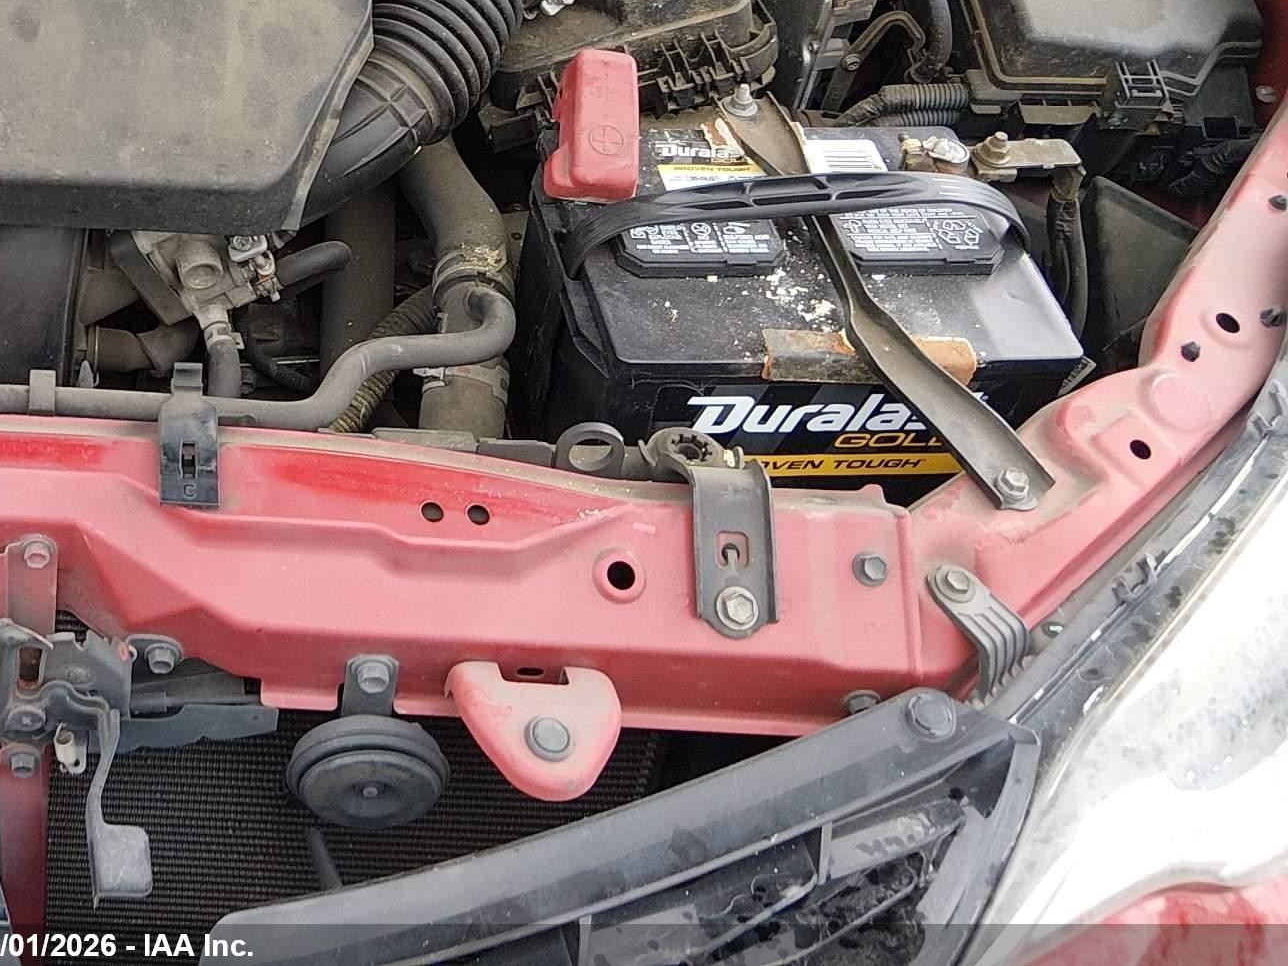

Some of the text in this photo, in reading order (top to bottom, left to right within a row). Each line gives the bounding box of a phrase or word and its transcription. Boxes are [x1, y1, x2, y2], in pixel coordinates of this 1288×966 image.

[687, 391, 985, 434] Durala
[761, 458, 921, 470] VEN TOUGH
